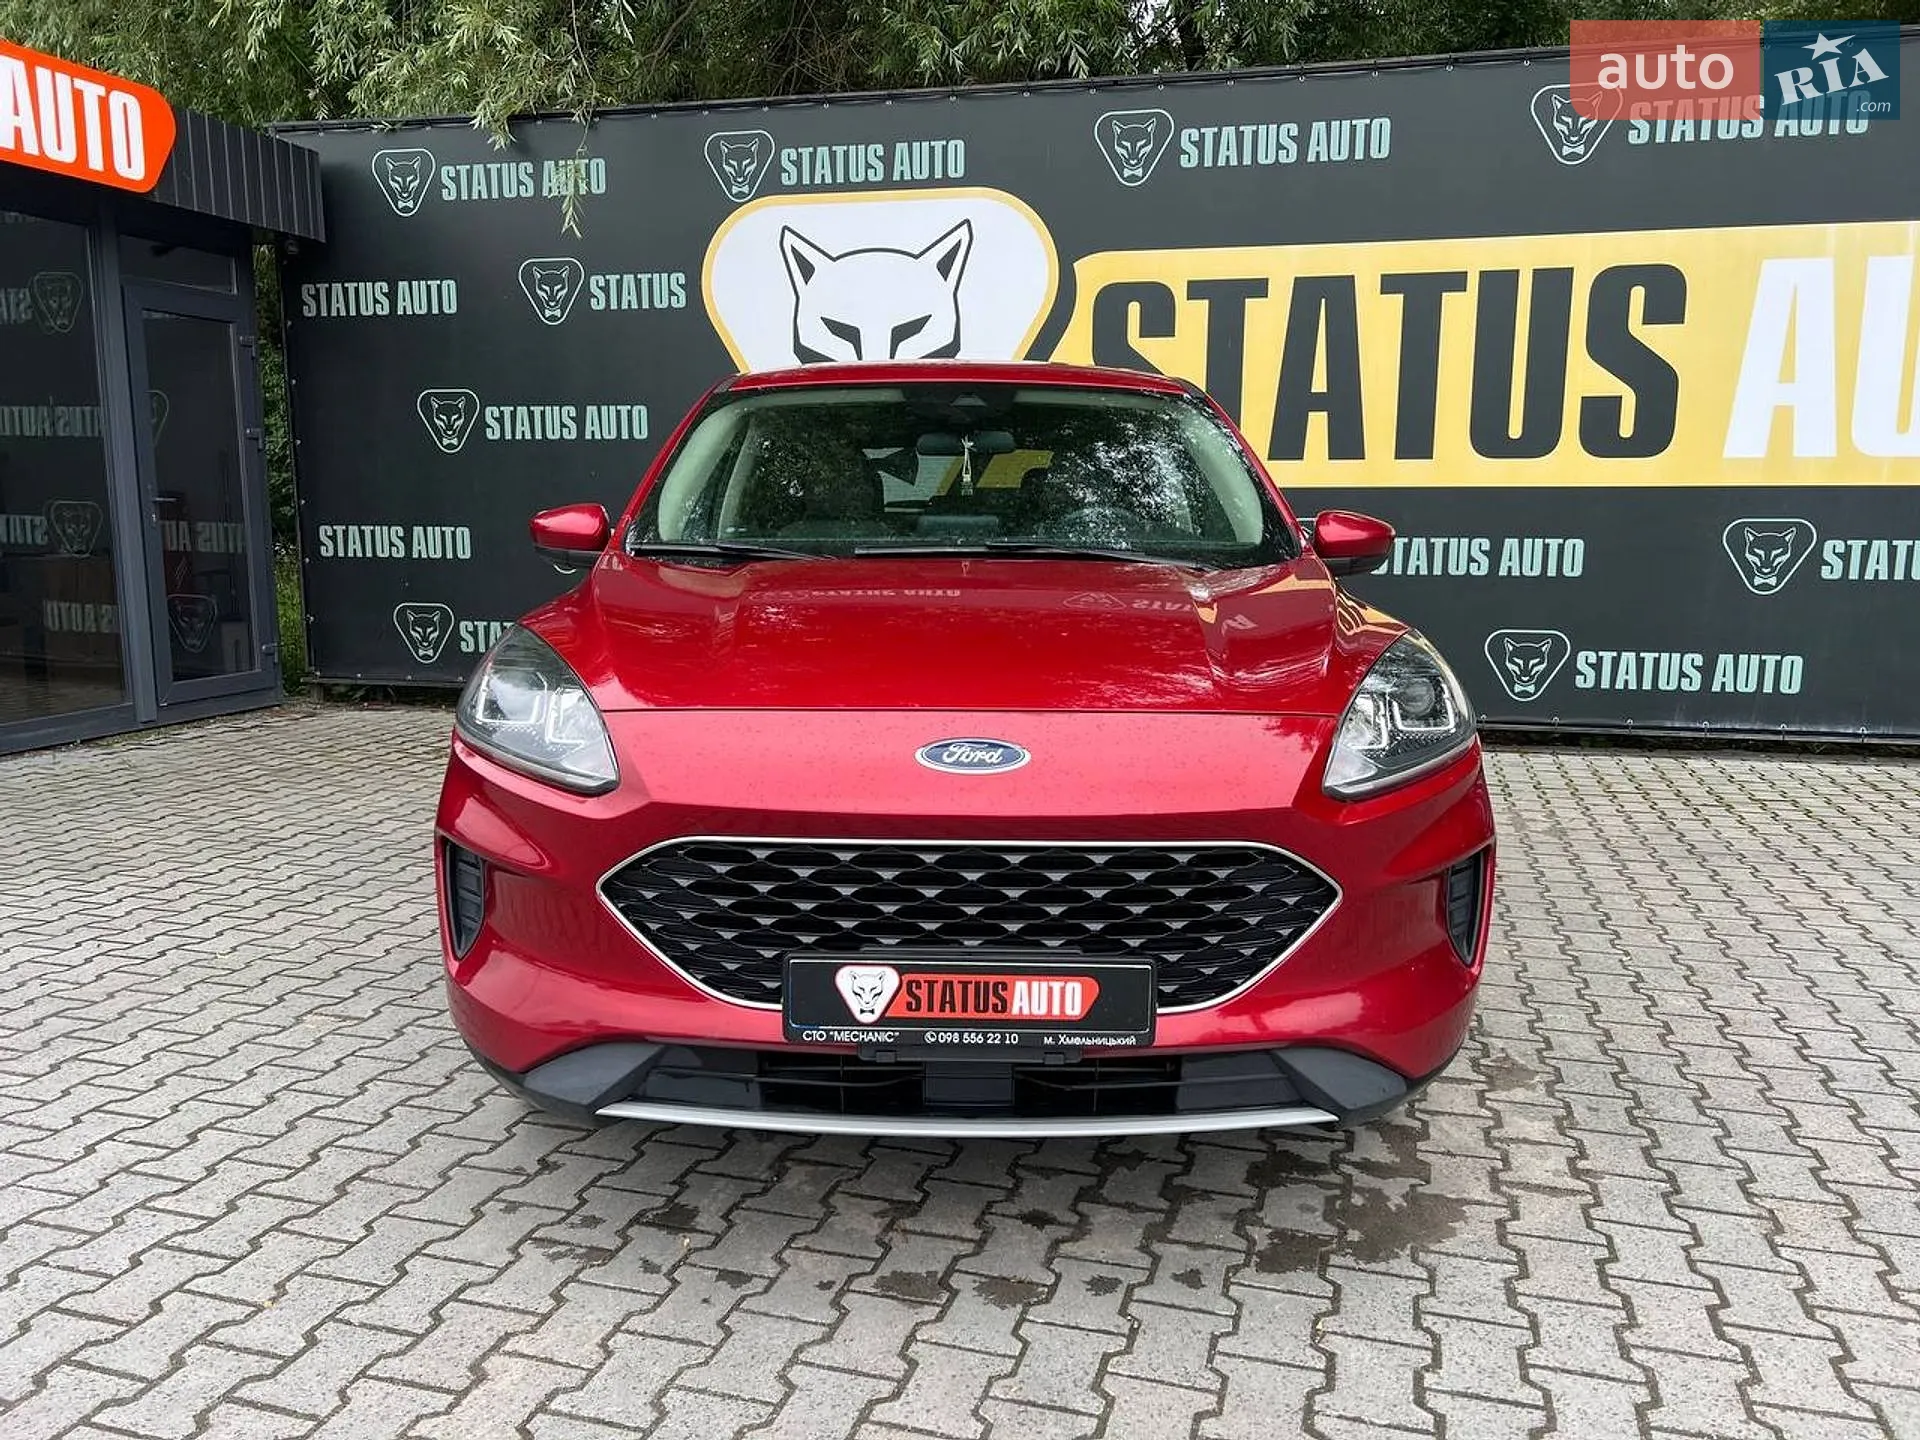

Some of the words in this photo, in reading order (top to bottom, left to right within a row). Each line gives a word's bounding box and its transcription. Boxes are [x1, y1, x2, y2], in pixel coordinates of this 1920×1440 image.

[0, 55, 146, 181] AUTO
[1627, 95, 1764, 145] STATUS
[1774, 90, 1872, 138] AUTO
[780, 143, 885, 186] STATUS
[892, 139, 965, 181] AUTO
[1179, 122, 1299, 169] STATUS
[1306, 117, 1391, 163] AUTO
[440, 162, 535, 201] STATUS
[542, 158, 606, 197] AUTO
[301, 281, 390, 317] STATUS
[397, 279, 458, 316] AUTO
[589, 272, 687, 311] STATUS
[484, 405, 578, 440] STATUS
[584, 404, 649, 440] AUTO
[319, 525, 406, 558] STATUS
[412, 525, 472, 560] AUTO
[1371, 538, 1491, 575] TATUS
[1498, 537, 1585, 577] AUTO
[1575, 650, 1704, 692] STATUS
[1711, 653, 1804, 695] AUTO
[942, 742, 1003, 764] Ford
[906, 979, 1008, 1014] STATUS
[1011, 980, 1083, 1016] AUTO
[937, 1031, 960, 1044] 098
[962, 1032, 984, 1044] 556
[986, 1032, 1001, 1045] 22
[1004, 1033, 1019, 1045] 10
